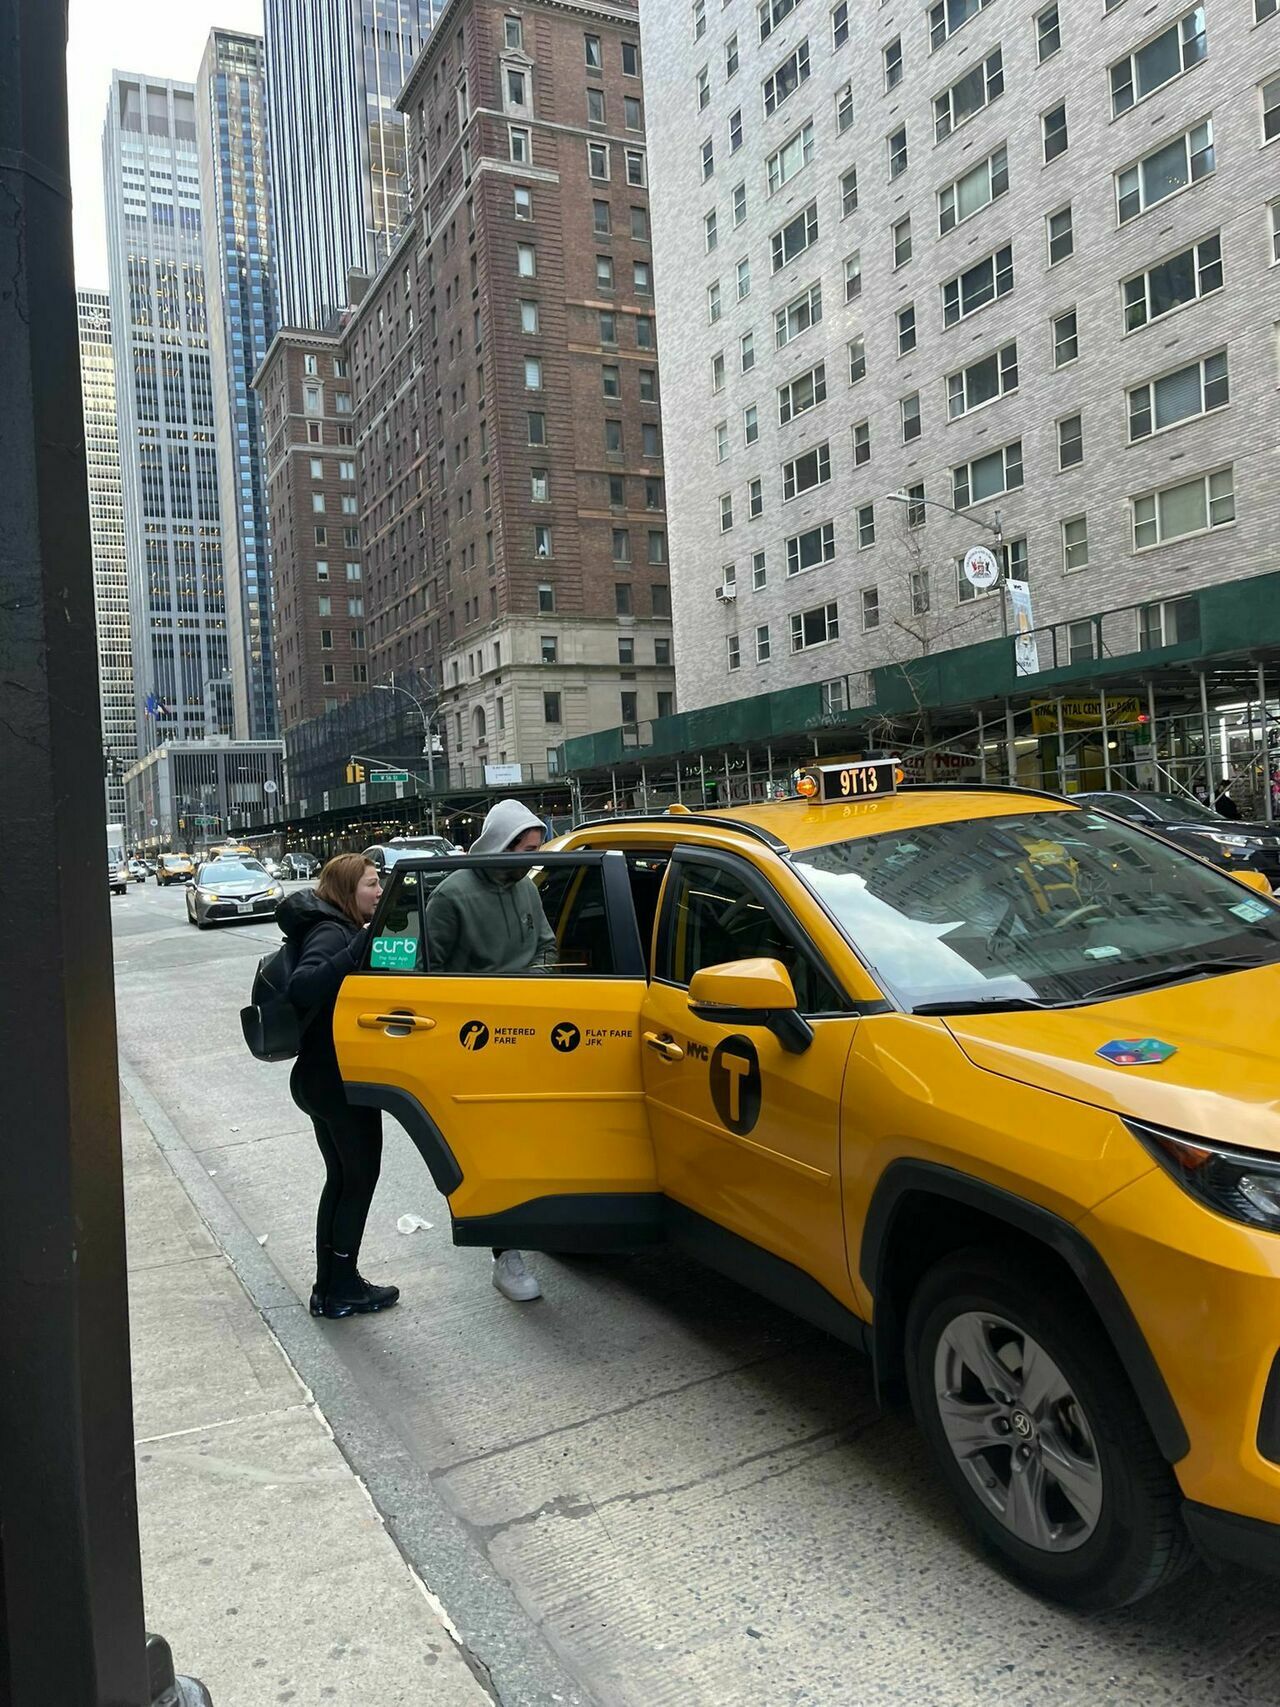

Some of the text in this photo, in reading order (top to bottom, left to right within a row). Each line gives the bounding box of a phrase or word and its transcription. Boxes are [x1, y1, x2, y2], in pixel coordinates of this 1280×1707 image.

[1052, 703, 1081, 715] RNTAL
[1083, 702, 1115, 715] CENTAL
[840, 767, 878, 795] 9T13
[373, 939, 416, 954] curb
[494, 1028, 536, 1036] METERED
[585, 1029, 633, 1038] FLAT FARE
[494, 1037, 517, 1045] FARE
[687, 1041, 709, 1062] NYC
[721, 1052, 750, 1122] T
